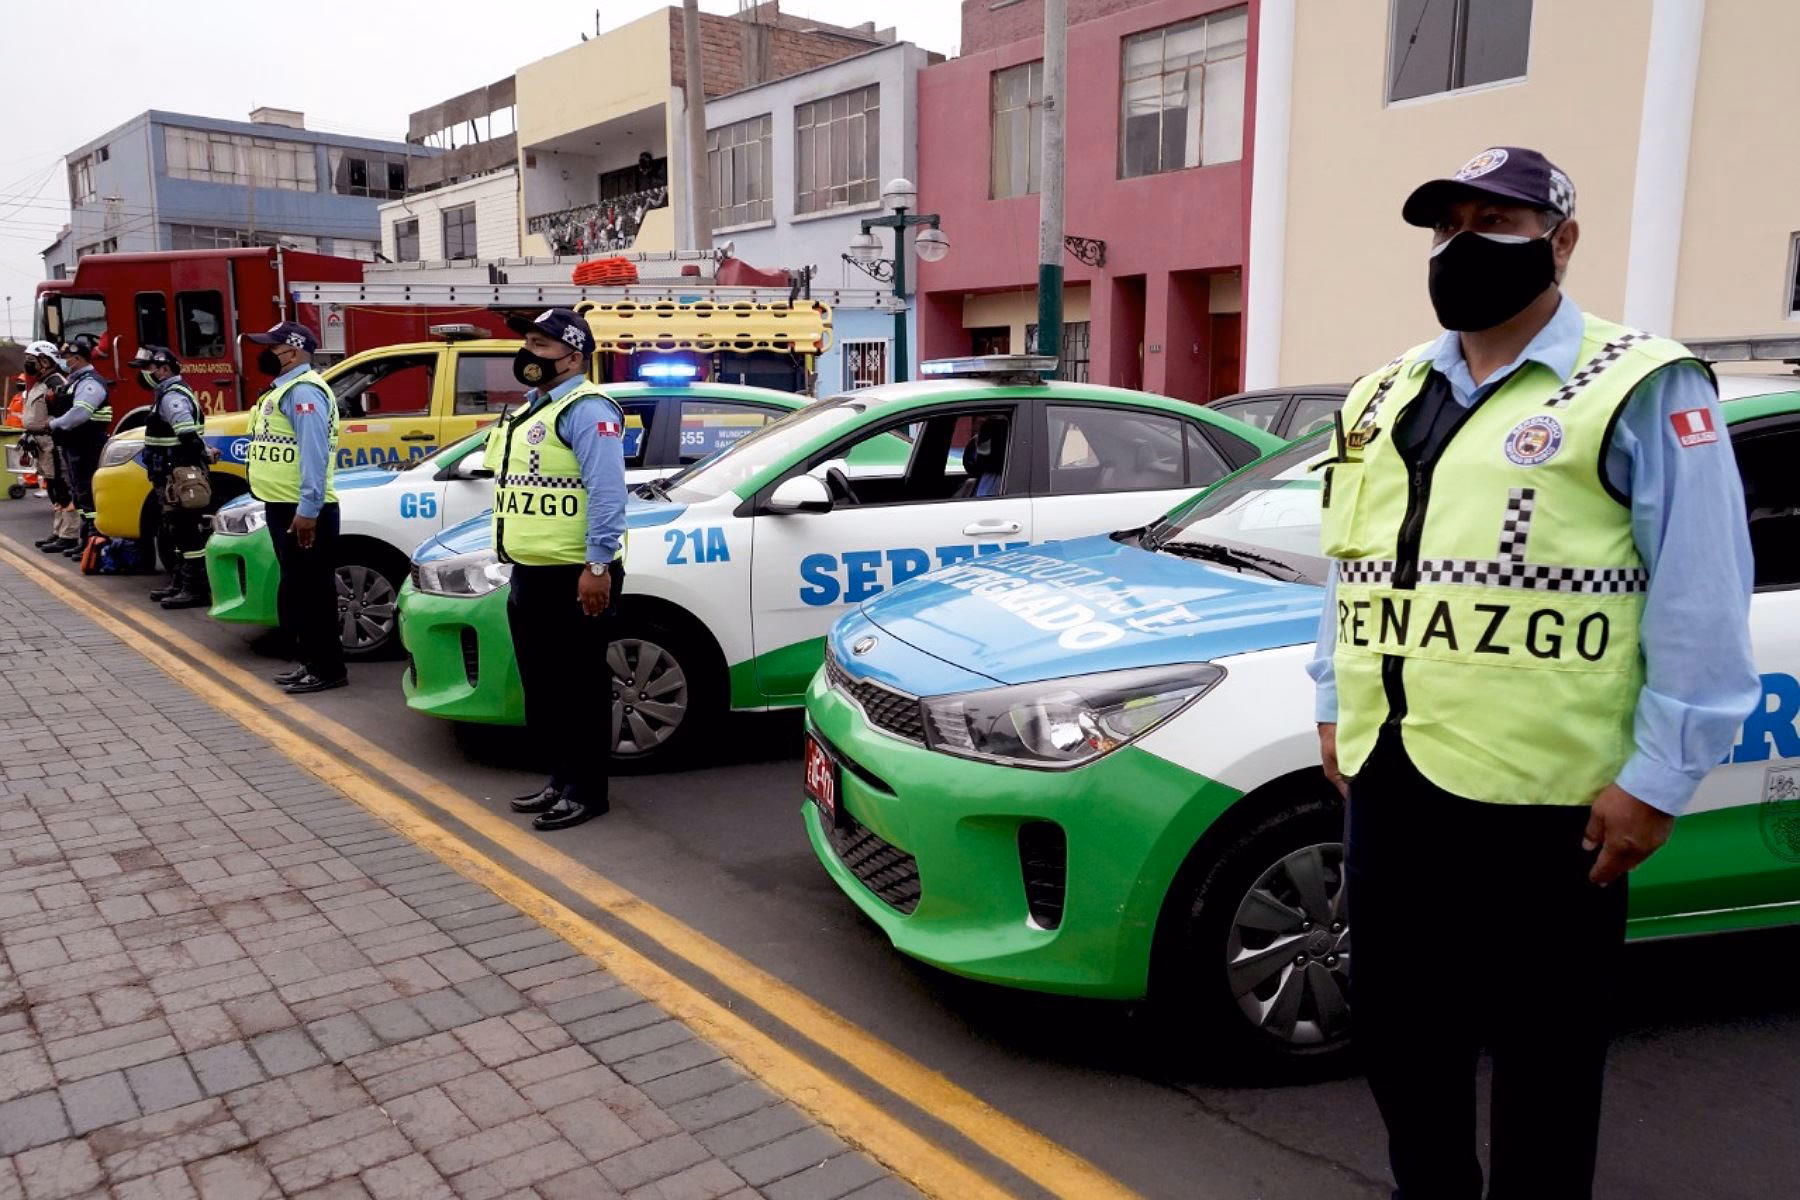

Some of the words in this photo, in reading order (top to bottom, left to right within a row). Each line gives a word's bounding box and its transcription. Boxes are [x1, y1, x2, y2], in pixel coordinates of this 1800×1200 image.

[400, 492, 437, 519] G5
[496, 491, 578, 517] NAZGO
[664, 527, 730, 564] 21A
[1339, 597, 1610, 662] RENAZGO
